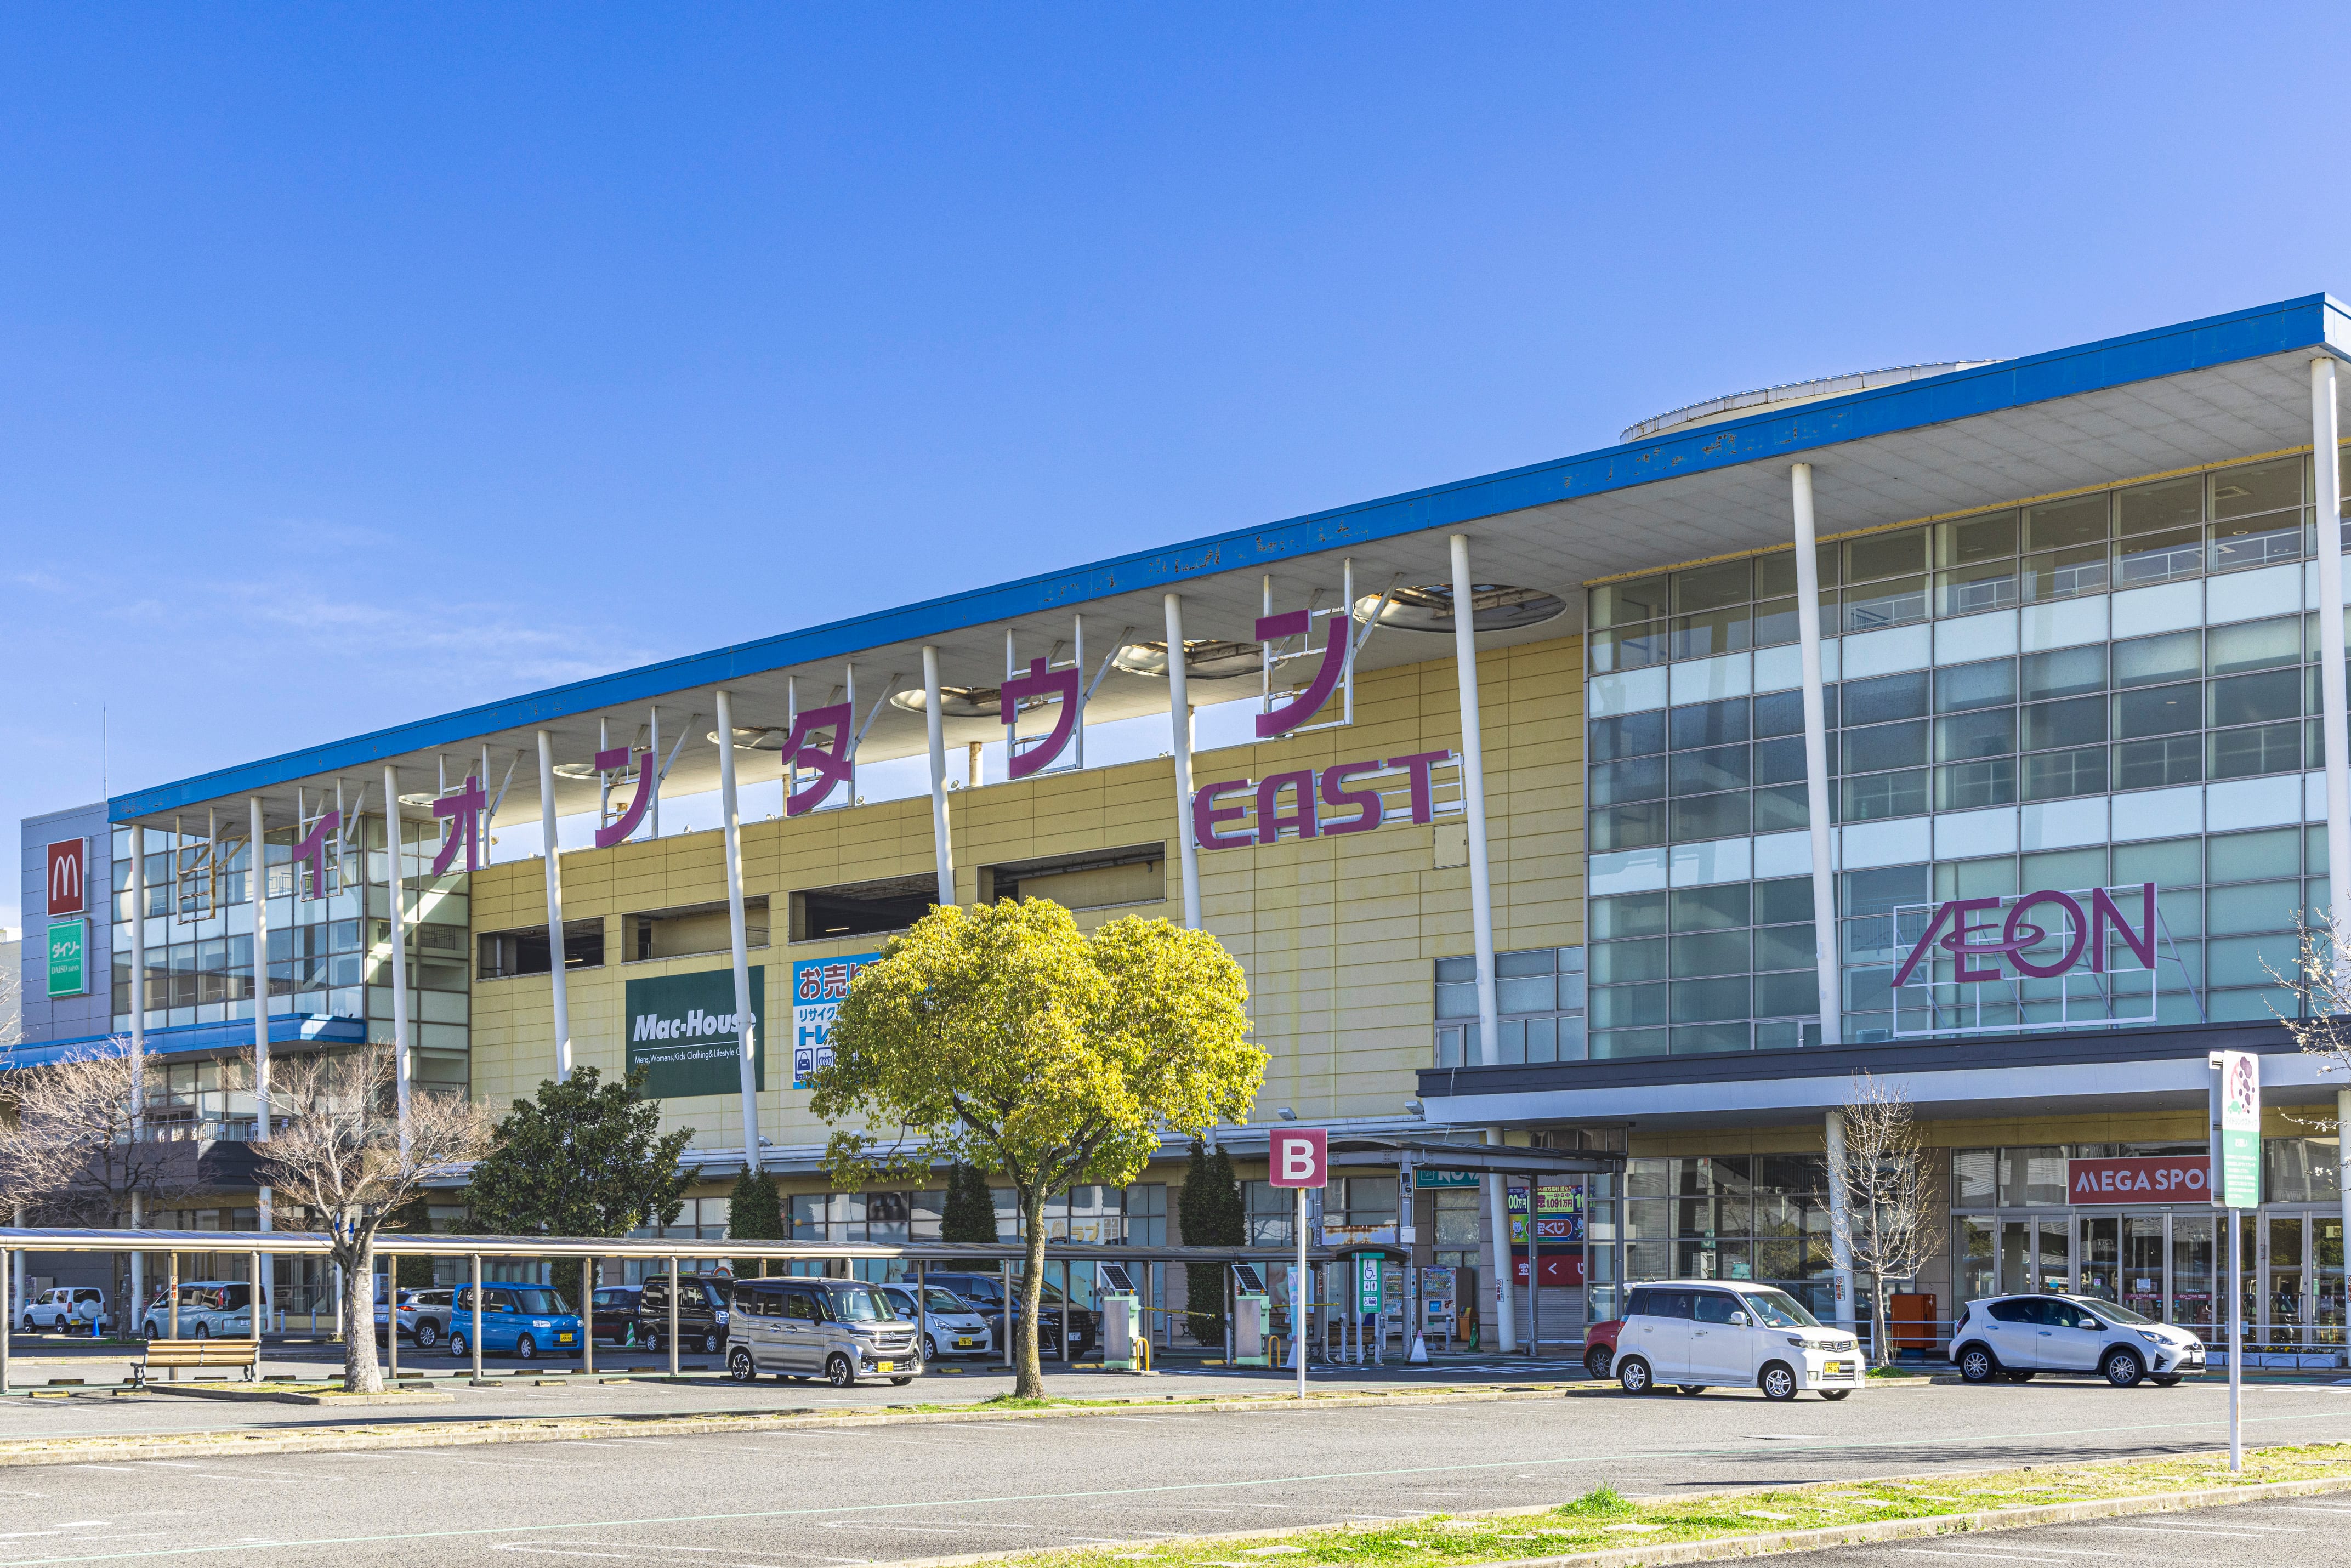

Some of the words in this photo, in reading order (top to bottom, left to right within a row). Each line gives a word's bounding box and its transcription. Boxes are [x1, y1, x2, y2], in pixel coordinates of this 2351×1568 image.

[293, 610, 1350, 898] イオンタウン
[1194, 748, 1449, 849] EAST
[52, 941, 79, 958] ダイソー
[52, 965, 67, 974] DAISO
[800, 1007, 841, 1022] リサイク
[714, 1048, 735, 1059] Lifestyle
[1282, 1139, 1315, 1179] B
[2075, 1169, 2151, 1193] MEGA
